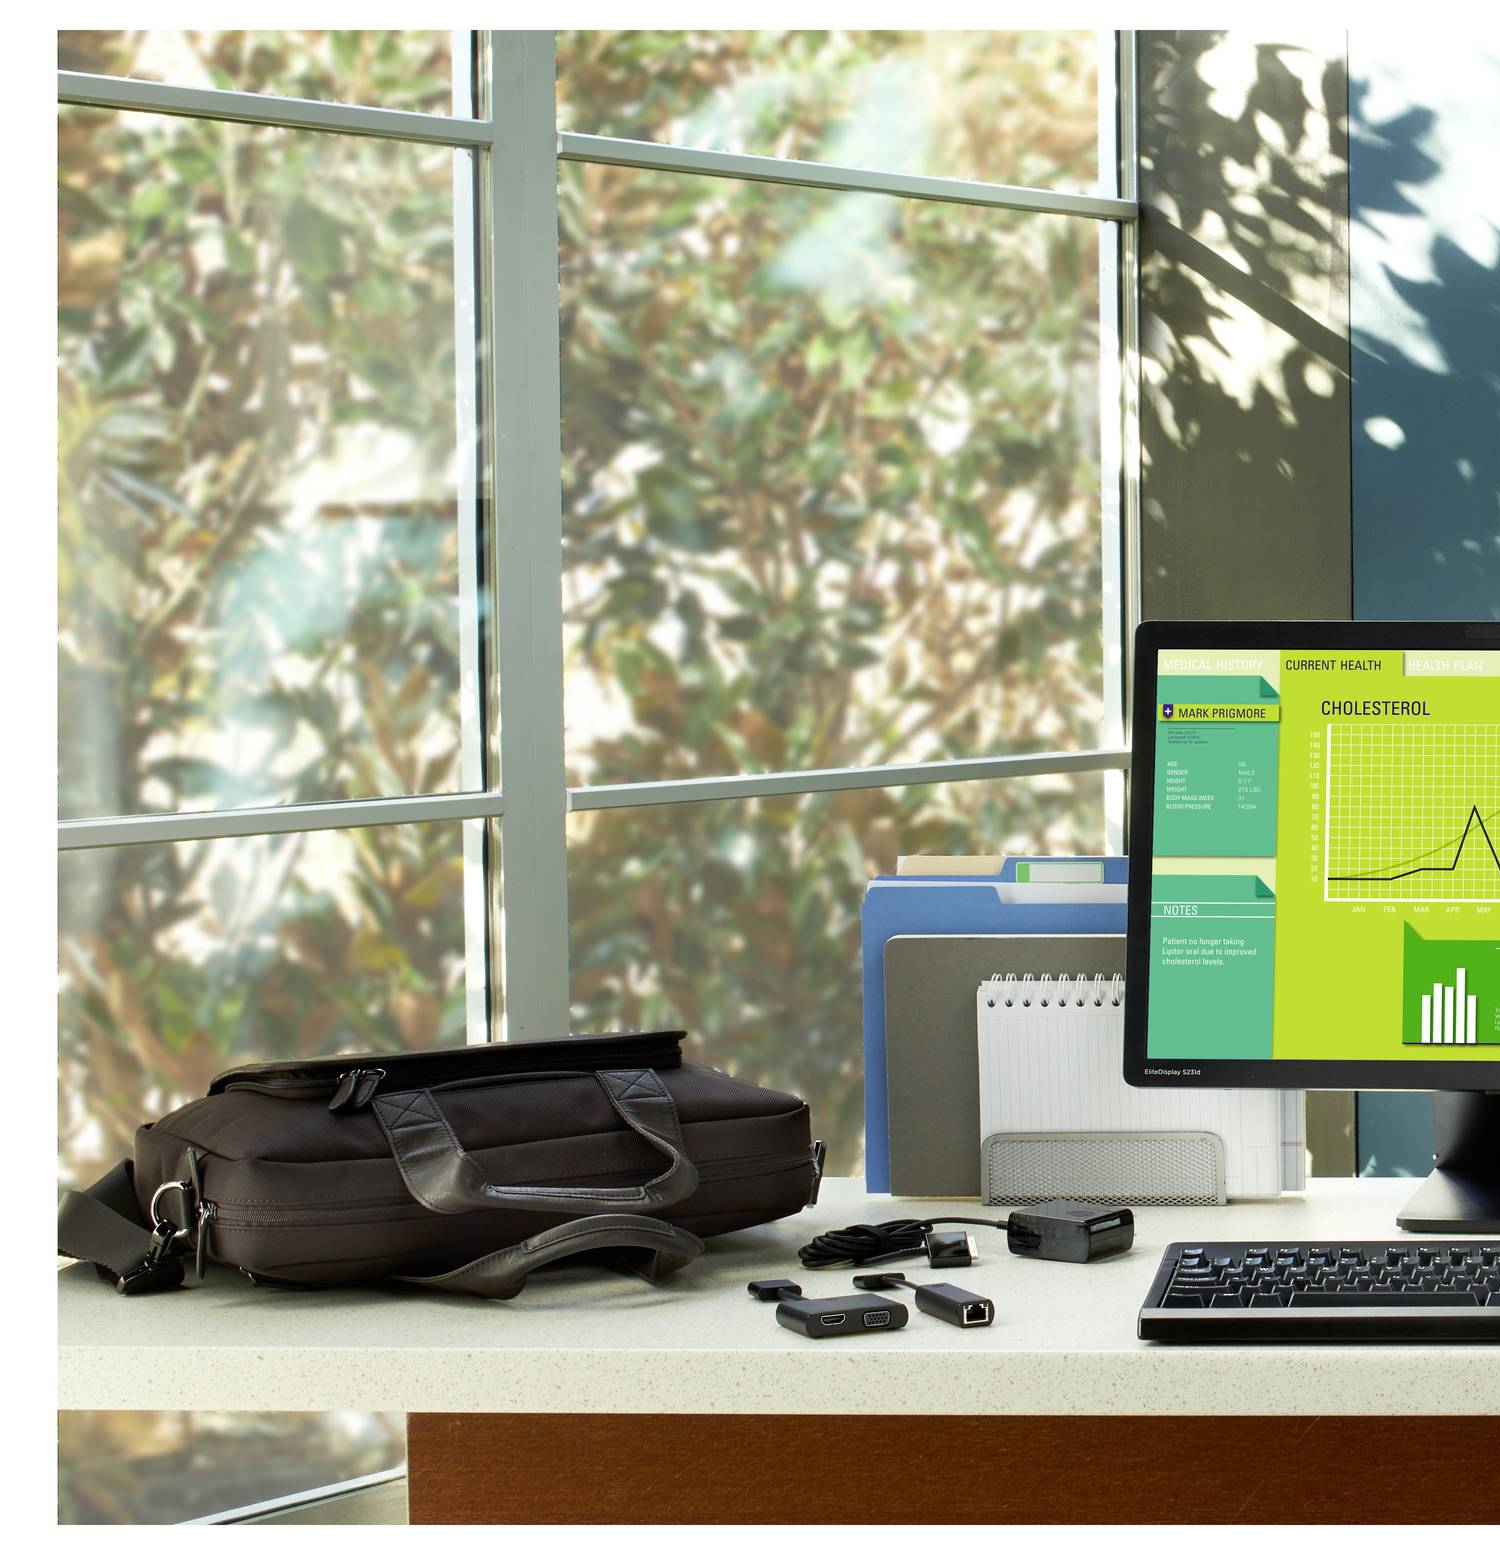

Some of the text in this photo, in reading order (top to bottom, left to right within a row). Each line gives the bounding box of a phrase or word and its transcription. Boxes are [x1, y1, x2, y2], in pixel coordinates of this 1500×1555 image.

[1286, 660, 1381, 670] CURRENT HEALTH
[1408, 661, 1484, 672] HEALTH PLAN
[1178, 708, 1265, 718] MARK PRIGMORE
[1322, 700, 1430, 716] CHOLESTEROL
[1164, 905, 1198, 915] NOTES
[1351, 906, 1366, 914] JAN
[1383, 906, 1397, 914] FEB
[1413, 906, 1430, 914] MAR
[1445, 906, 1460, 914] APR
[1477, 906, 1492, 914] MAY
[1162, 937, 1187, 945] Patient
[1199, 937, 1220, 947] longer
[1223, 938, 1245, 947] taking
[1162, 947, 1184, 957] Lipitor
[1184, 948, 1199, 956] oral
[1224, 948, 1256, 957] improved
[1162, 958, 1224, 966] cholesterol levels.
[1144, 1068, 1181, 1076] EliteDisplay
